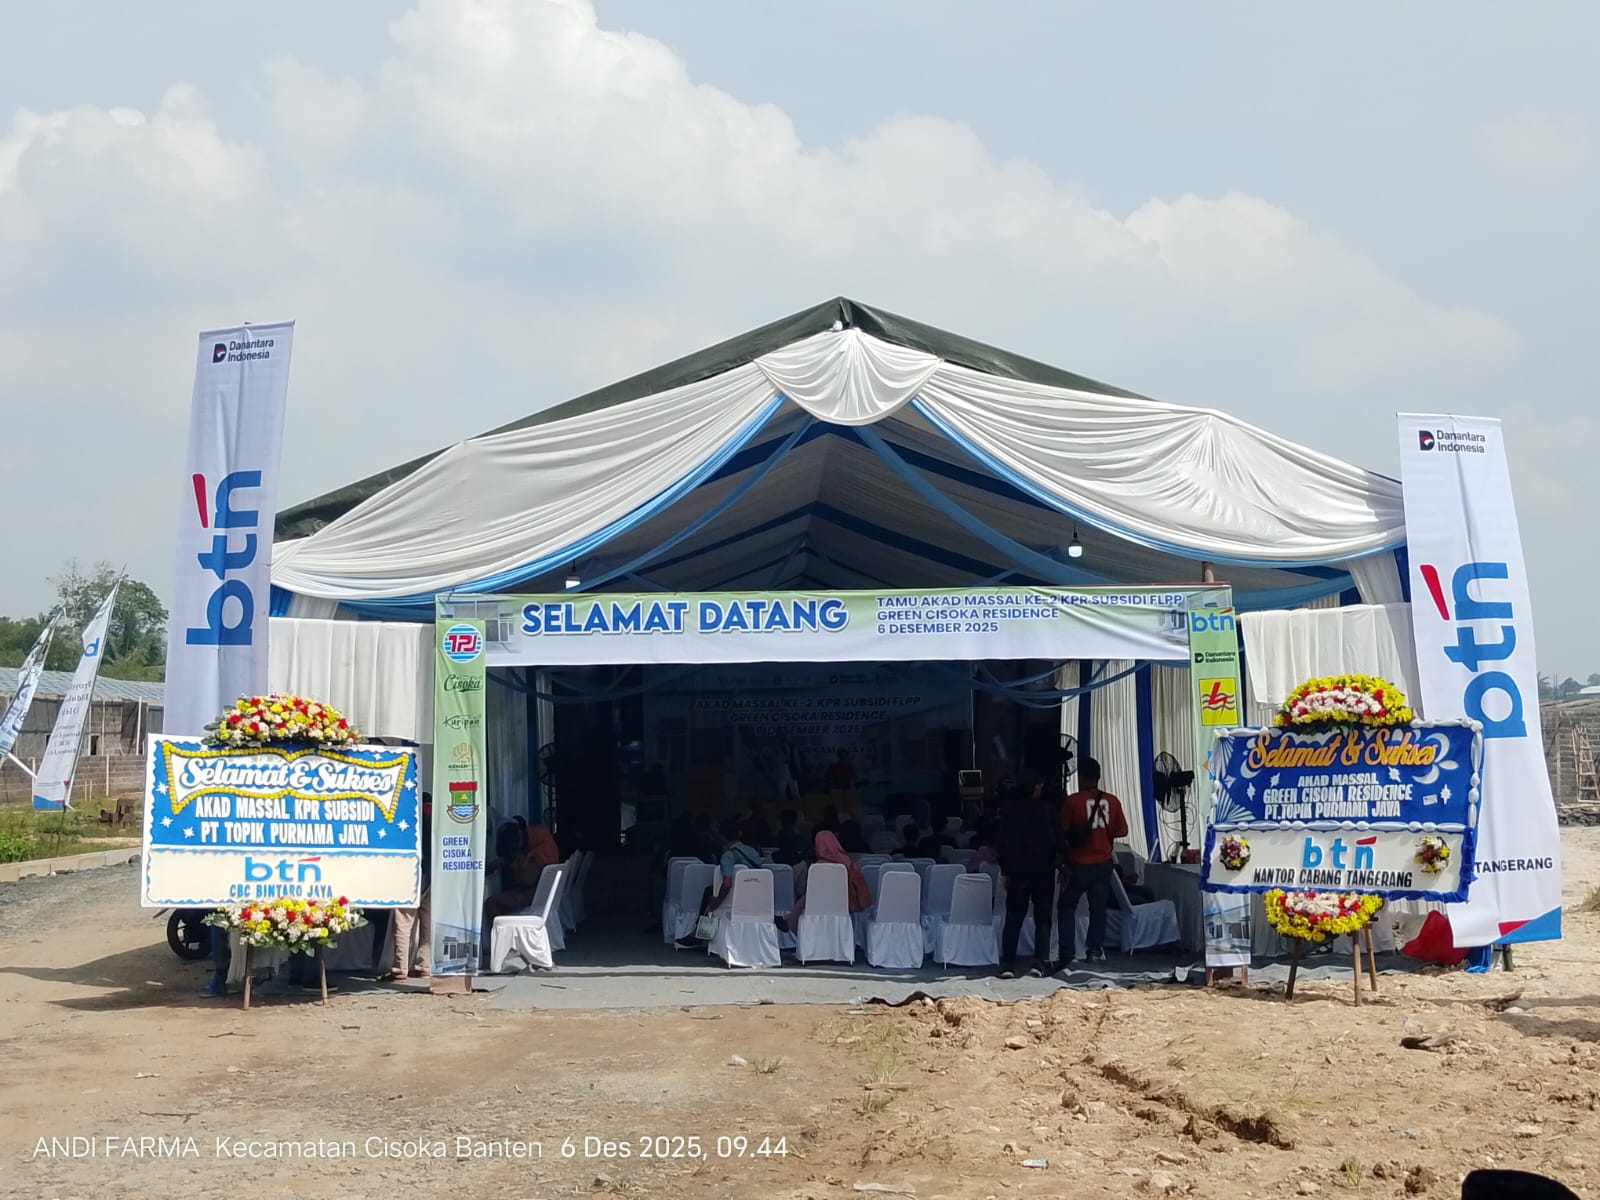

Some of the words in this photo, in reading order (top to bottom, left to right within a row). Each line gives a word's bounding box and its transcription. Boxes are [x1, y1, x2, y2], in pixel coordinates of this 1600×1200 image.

[229, 337, 274, 352] Danantara
[227, 350, 270, 363] Indonesia
[1437, 429, 1486, 443] Danantara
[1437, 441, 1486, 454] Indonesia
[185, 470, 262, 646] btn
[876, 597, 918, 608] TAMU
[921, 596, 961, 607] AKAD
[964, 595, 1022, 607] MASSAL
[1060, 595, 1088, 606] KPR
[1091, 595, 1147, 606] SUBSIDI
[1149, 594, 1183, 606] FLPP
[521, 602, 689, 634] SELAMAT
[697, 600, 848, 632] DATANG
[876, 609, 923, 621] GREEN
[925, 609, 980, 620] CISOKA
[982, 608, 1059, 620] RESIDENCE
[1190, 608, 1235, 632] btn
[877, 622, 886, 634] 6
[888, 622, 962, 634] DESEMBER
[964, 622, 999, 633] 2025
[1419, 562, 1528, 738] btn
[443, 673, 481, 693] Cisoka
[442, 715, 480, 730] Kuripan
[771, 711, 819, 722] CISOKA
[1249, 728, 1341, 769] Selamat
[1342, 727, 1363, 767] &
[1365, 728, 1439, 767] Sukses
[181, 755, 290, 788] Selamat
[289, 760, 313, 790] &
[312, 762, 394, 793] Sukses
[1298, 774, 1329, 788] AKAD
[1331, 772, 1379, 787] MASSAL
[1263, 788, 1297, 805] GREEN
[1301, 786, 1344, 804] CISOKA
[1347, 784, 1413, 802] RESIDENCE
[195, 797, 231, 819] AKAD
[235, 798, 290, 820] MASSAL
[294, 799, 321, 821] KPR
[324, 800, 375, 822] SUBSIDI
[1315, 802, 1368, 819] PURNAMA
[1371, 801, 1400, 817] JAYA
[201, 822, 220, 843] PT
[224, 822, 265, 844] TOPIK
[270, 823, 335, 846] PURNAMA
[338, 824, 369, 846] JAYA
[442, 836, 469, 847] GREEN
[442, 848, 472, 859] CISOKA
[1302, 836, 1378, 869] btn
[244, 856, 321, 883] btn
[442, 860, 484, 871] RESIDENCE
[1475, 857, 1553, 873] TANGERANG
[1253, 867, 1296, 886] KANTOR
[1300, 868, 1342, 887] CABANG
[1346, 869, 1413, 888] TANGERANG
[229, 884, 251, 898] CBC
[255, 884, 302, 898] BINTARO
[307, 884, 333, 898] JAYA
